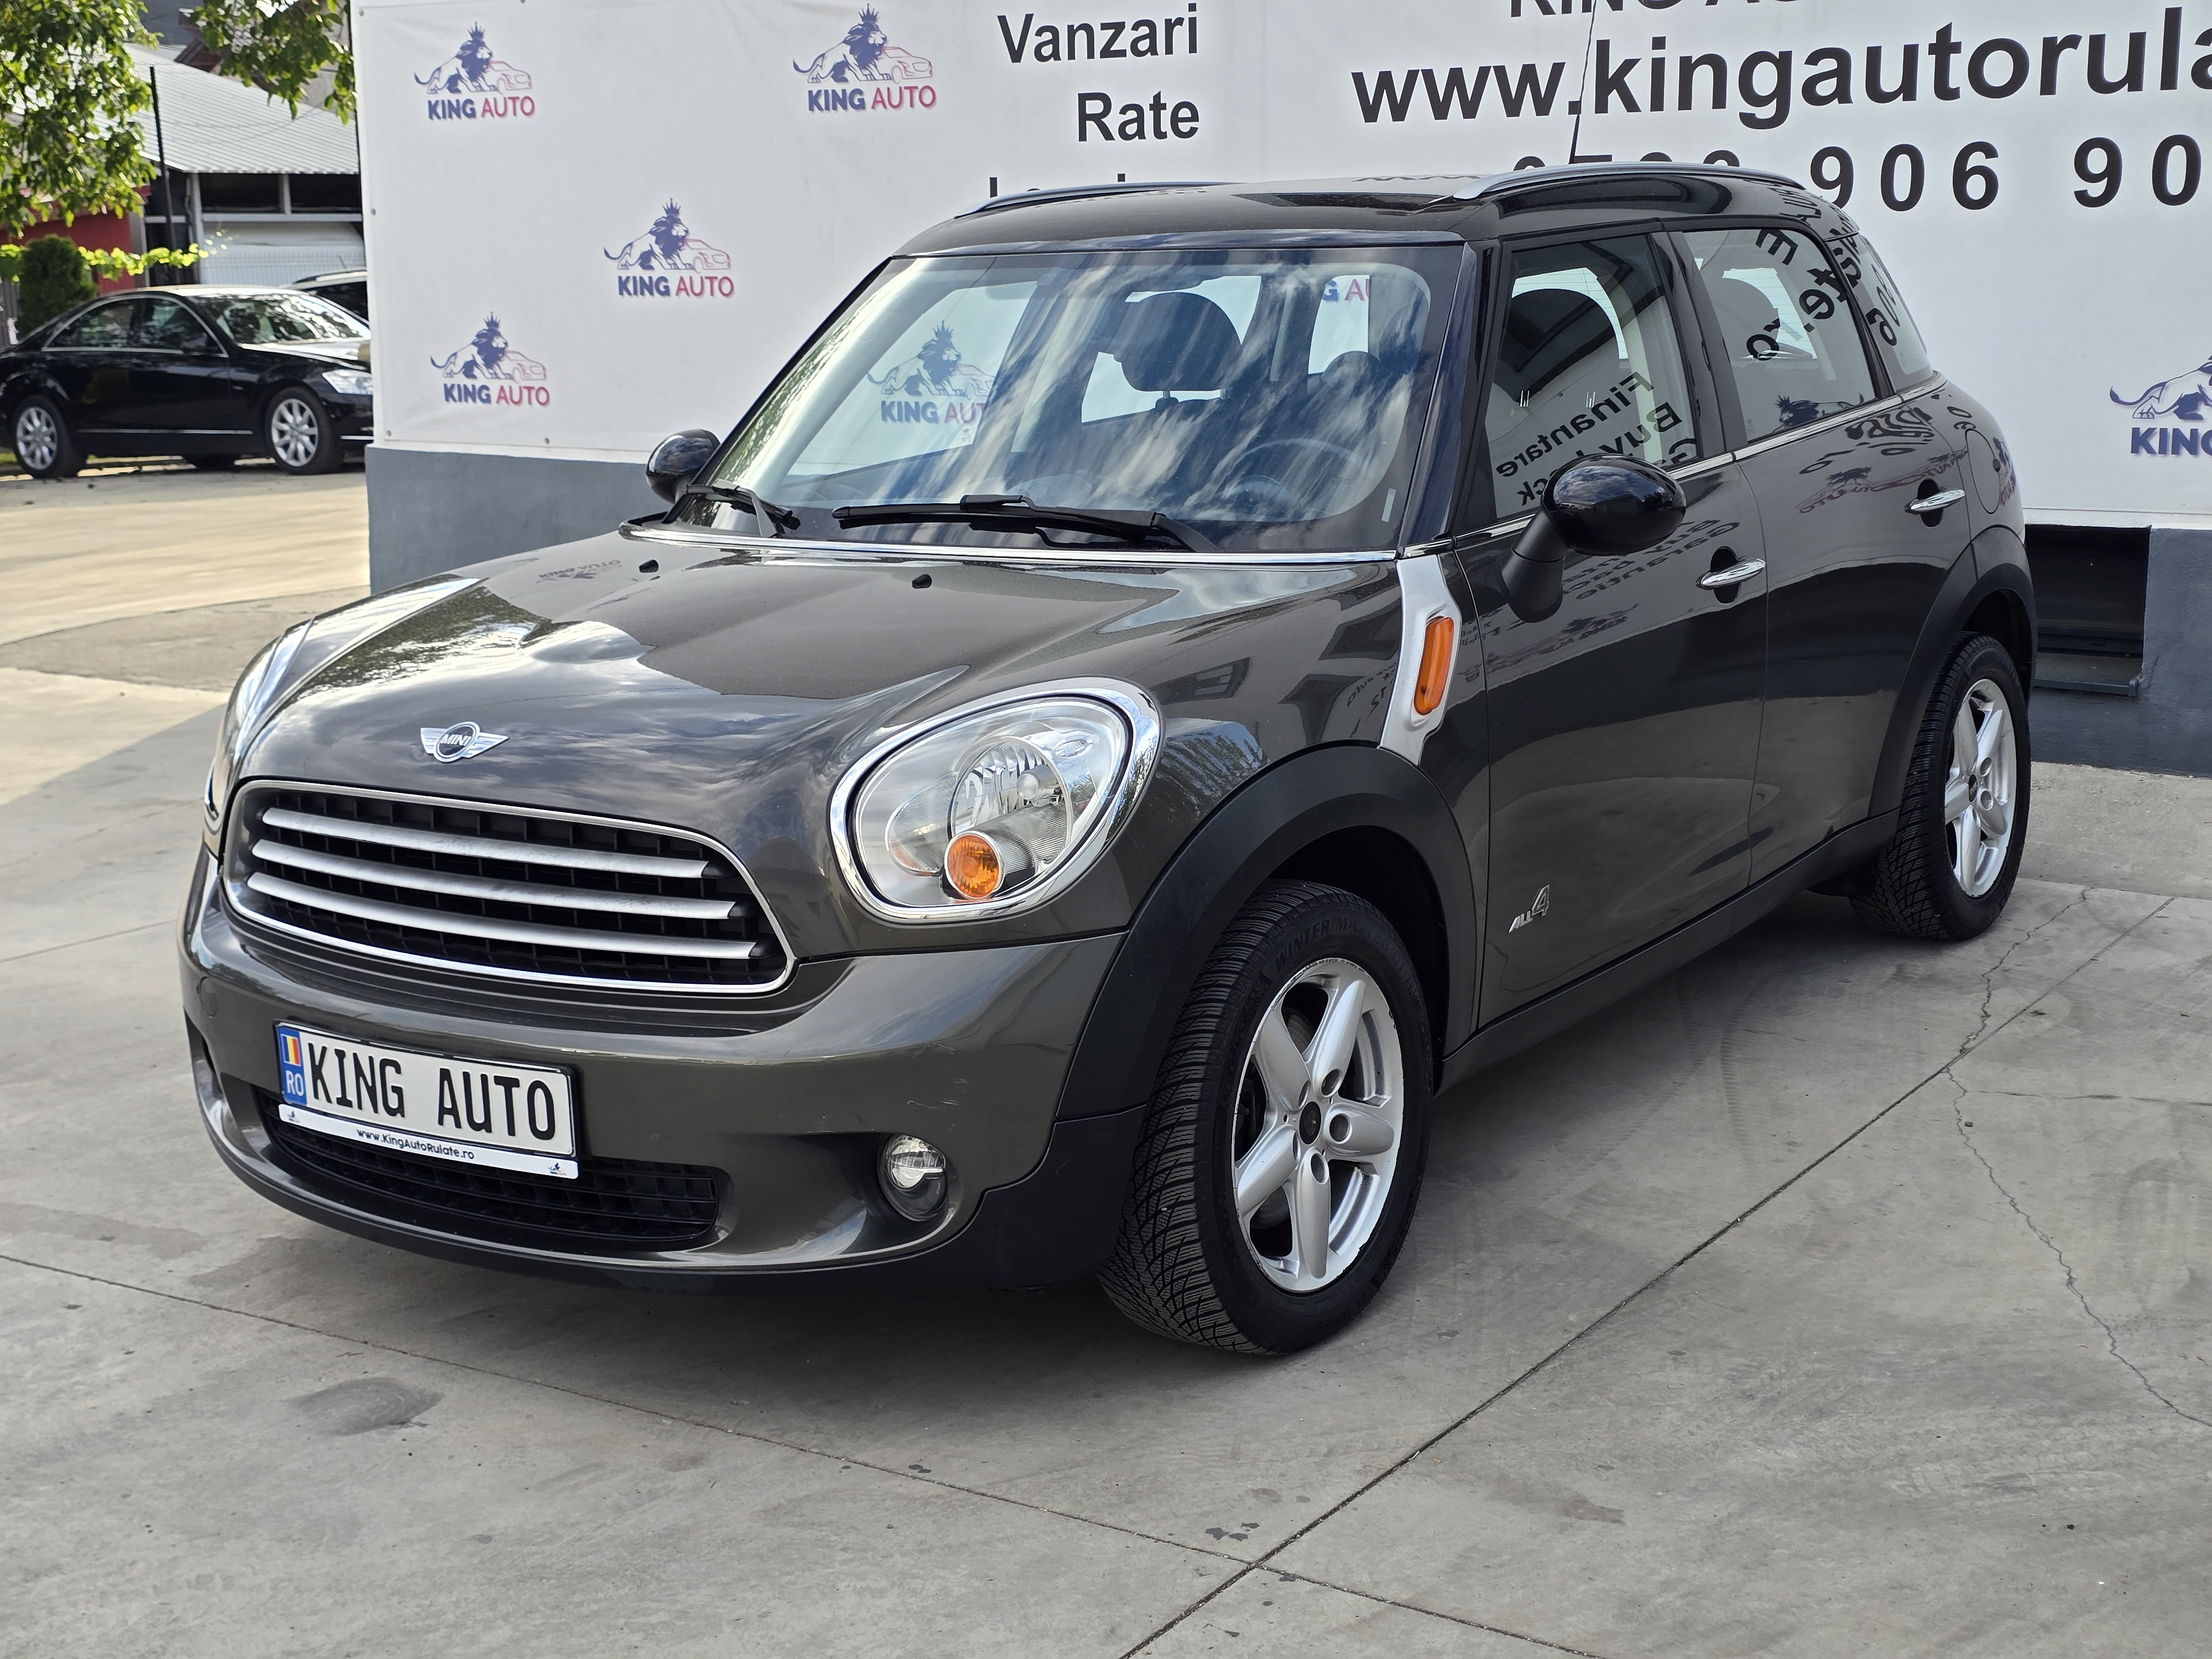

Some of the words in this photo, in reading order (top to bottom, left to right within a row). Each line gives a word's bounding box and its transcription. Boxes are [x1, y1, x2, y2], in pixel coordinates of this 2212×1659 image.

[997, 3, 1198, 64] Vanzari
[427, 98, 476, 120] KING
[481, 96, 535, 118] AUTO
[807, 87, 865, 112] KING
[871, 85, 937, 110] AUTO
[1077, 90, 1201, 142] Rate
[1810, 140, 2000, 212] 906
[617, 276, 671, 297] KING
[675, 276, 735, 298] AUTO
[444, 383, 492, 404] KING
[495, 385, 550, 406] AUTO
[880, 400, 939, 424] KING
[944, 402, 986, 424] AUT
[440, 734, 471, 747] MINI
[1274, 919, 1331, 973] WINTER
[286, 1070, 305, 1097] RO
[307, 1042, 406, 1118] KING
[437, 1068, 556, 1141] AUTO
[356, 1128, 474, 1160] www.KingAutoRulate.ro
